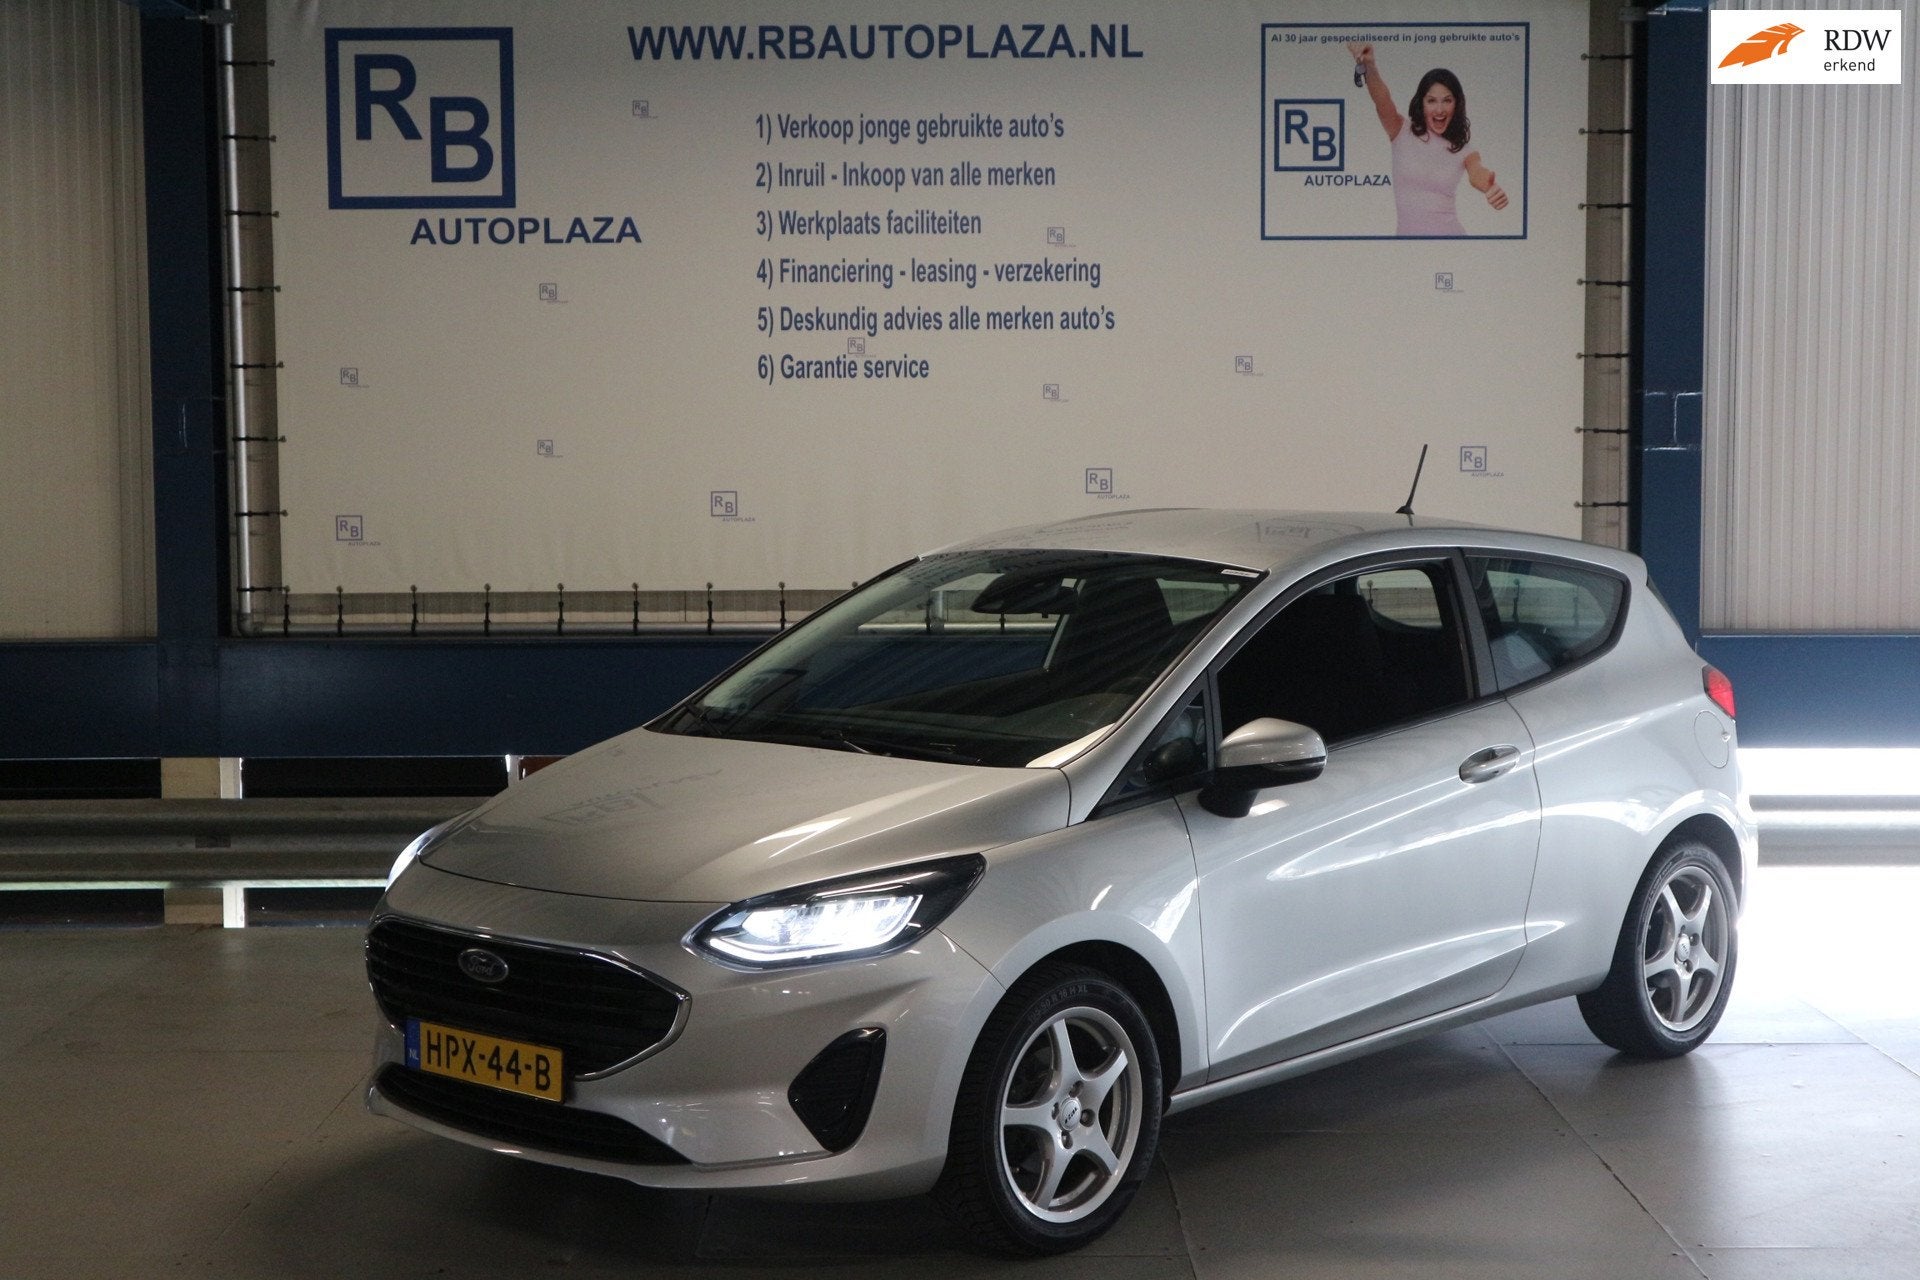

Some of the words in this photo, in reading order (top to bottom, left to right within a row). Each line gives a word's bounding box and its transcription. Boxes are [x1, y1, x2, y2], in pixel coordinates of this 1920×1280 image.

[627, 23, 1144, 61] WWW.RBAUTOPLAZA.NL
[1285, 33, 1297, 43] 30
[1299, 33, 1318, 45] jaar
[1320, 33, 1400, 45] gespecialiseerd
[1402, 33, 1412, 42] in
[1414, 33, 1437, 45] jong
[1439, 32, 1487, 44] gebruikte
[755, 113, 772, 145] 1)
[778, 113, 854, 145] Verkoop
[859, 112, 911, 145] jonge
[916, 112, 1003, 145] gebruikte
[1008, 112, 1065, 138] auto’s
[755, 162, 773, 193] 2)
[778, 162, 825, 188] Inruil
[843, 161, 906, 193] Inkoop
[911, 168, 944, 187] van
[949, 161, 982, 186] alle
[987, 161, 1056, 186] merken
[1304, 174, 1392, 187] AUTOPLAZA
[410, 217, 642, 246] AUTOPLAZA
[756, 210, 773, 241] 3)
[778, 209, 881, 241] Werkplaats
[886, 209, 982, 235] faciliteiten
[756, 258, 773, 289] 4)
[779, 258, 893, 290] Financiering
[911, 258, 977, 289] leasing
[994, 257, 1101, 288] verzekering
[757, 306, 774, 338] 5)
[780, 306, 878, 337] Deskundig
[883, 305, 943, 331] advies
[948, 305, 981, 330] alle
[986, 305, 1054, 330] merken
[1059, 304, 1115, 330] auto’s
[757, 354, 775, 386] 6)
[780, 353, 858, 379] Garantie
[863, 354, 930, 379] service
[467, 955, 496, 976] Ford
[409, 1049, 419, 1060] NL
[426, 1030, 551, 1091] HPX-44-B
